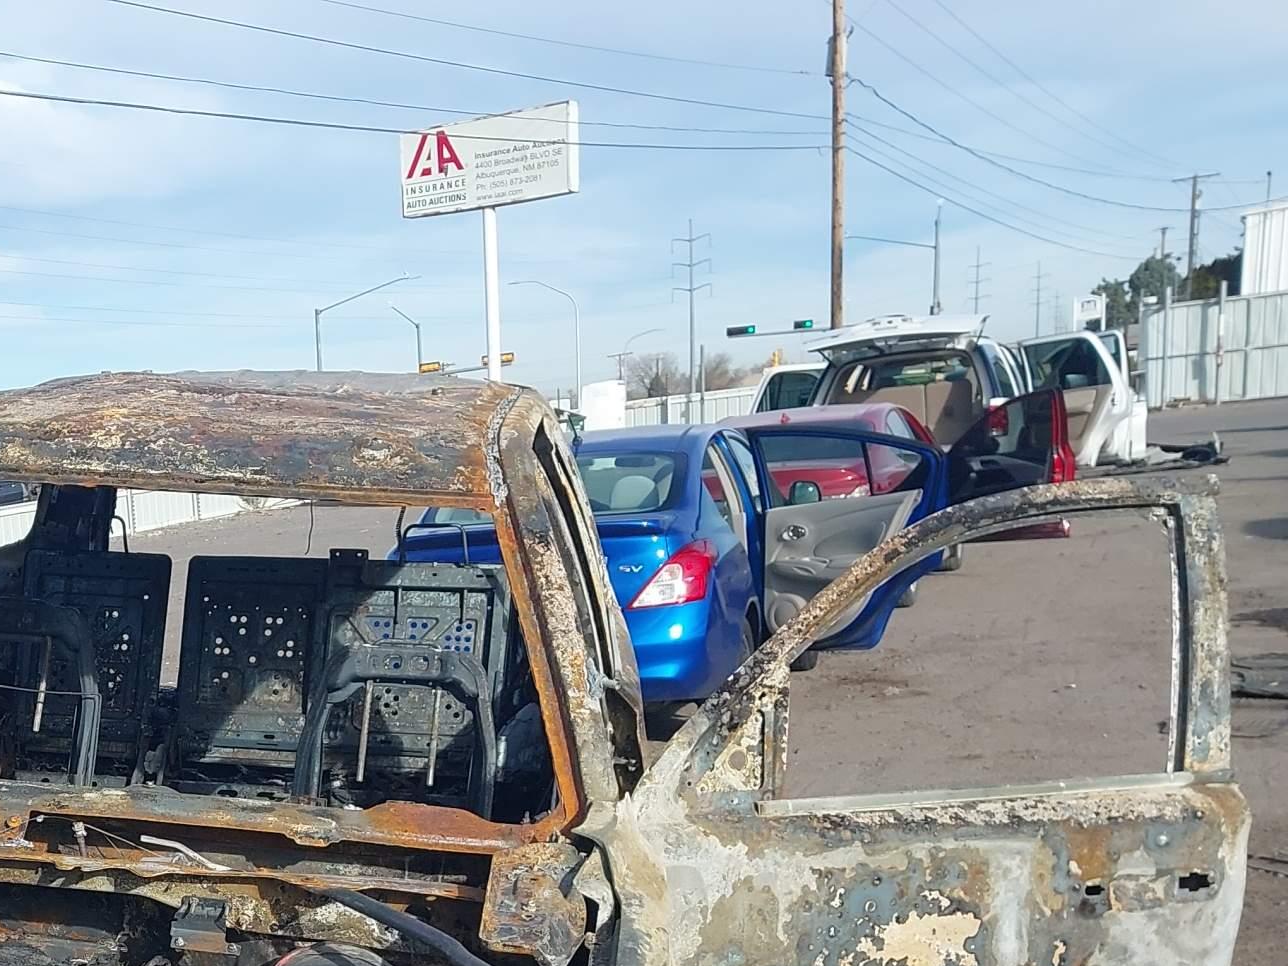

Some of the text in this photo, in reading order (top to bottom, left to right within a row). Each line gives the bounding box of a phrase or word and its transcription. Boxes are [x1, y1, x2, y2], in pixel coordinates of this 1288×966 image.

[475, 148, 511, 159] Insurance
[512, 145, 529, 153] Auto
[475, 147, 563, 169] 4400 Broadway BLVD SE
[522, 163, 535, 172] NM
[406, 178, 466, 195] INSURANCE
[406, 192, 466, 209] AUTO AUCTIONS
[618, 564, 643, 573] SV
